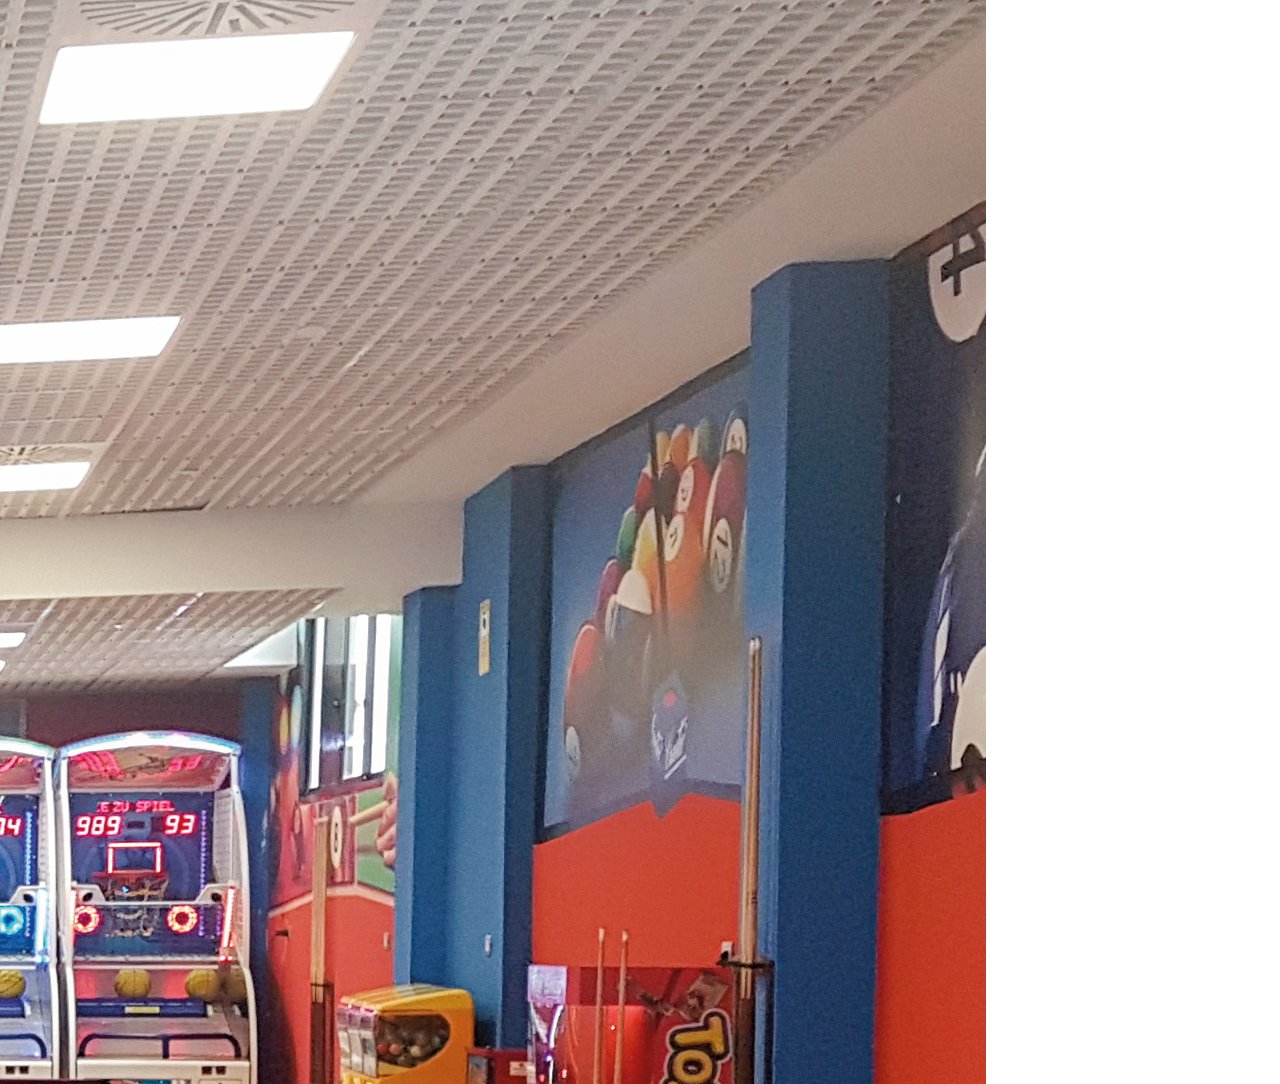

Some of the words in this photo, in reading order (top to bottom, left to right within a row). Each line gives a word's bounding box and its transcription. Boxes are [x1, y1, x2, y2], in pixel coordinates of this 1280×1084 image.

[136, 801, 175, 812] SPIEL
[76, 815, 122, 836] 989
[165, 814, 196, 835] 93
